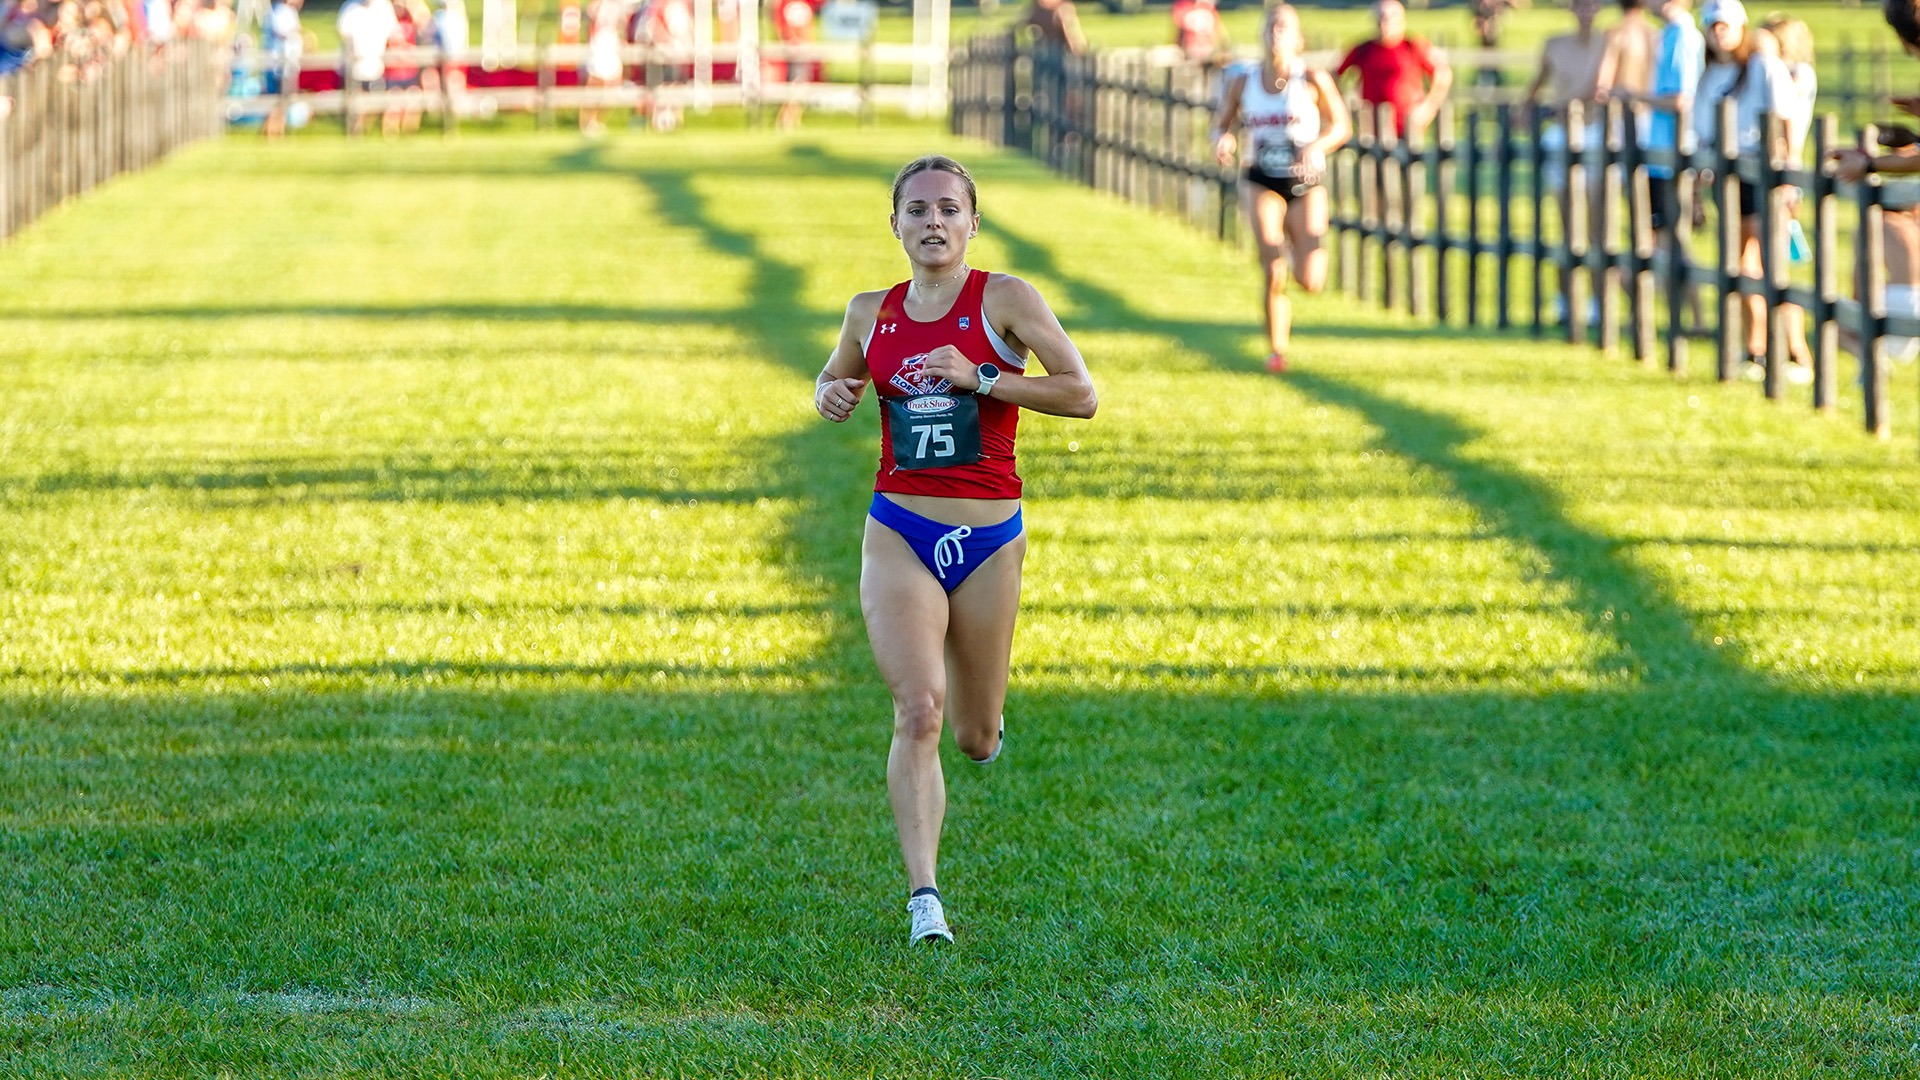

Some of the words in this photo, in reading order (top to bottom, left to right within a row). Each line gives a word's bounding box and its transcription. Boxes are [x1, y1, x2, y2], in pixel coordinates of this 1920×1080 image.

[891, 375, 920, 395] FLORID
[909, 400, 929, 409] Track
[929, 399, 955, 408] Shack
[911, 423, 955, 459] 75
